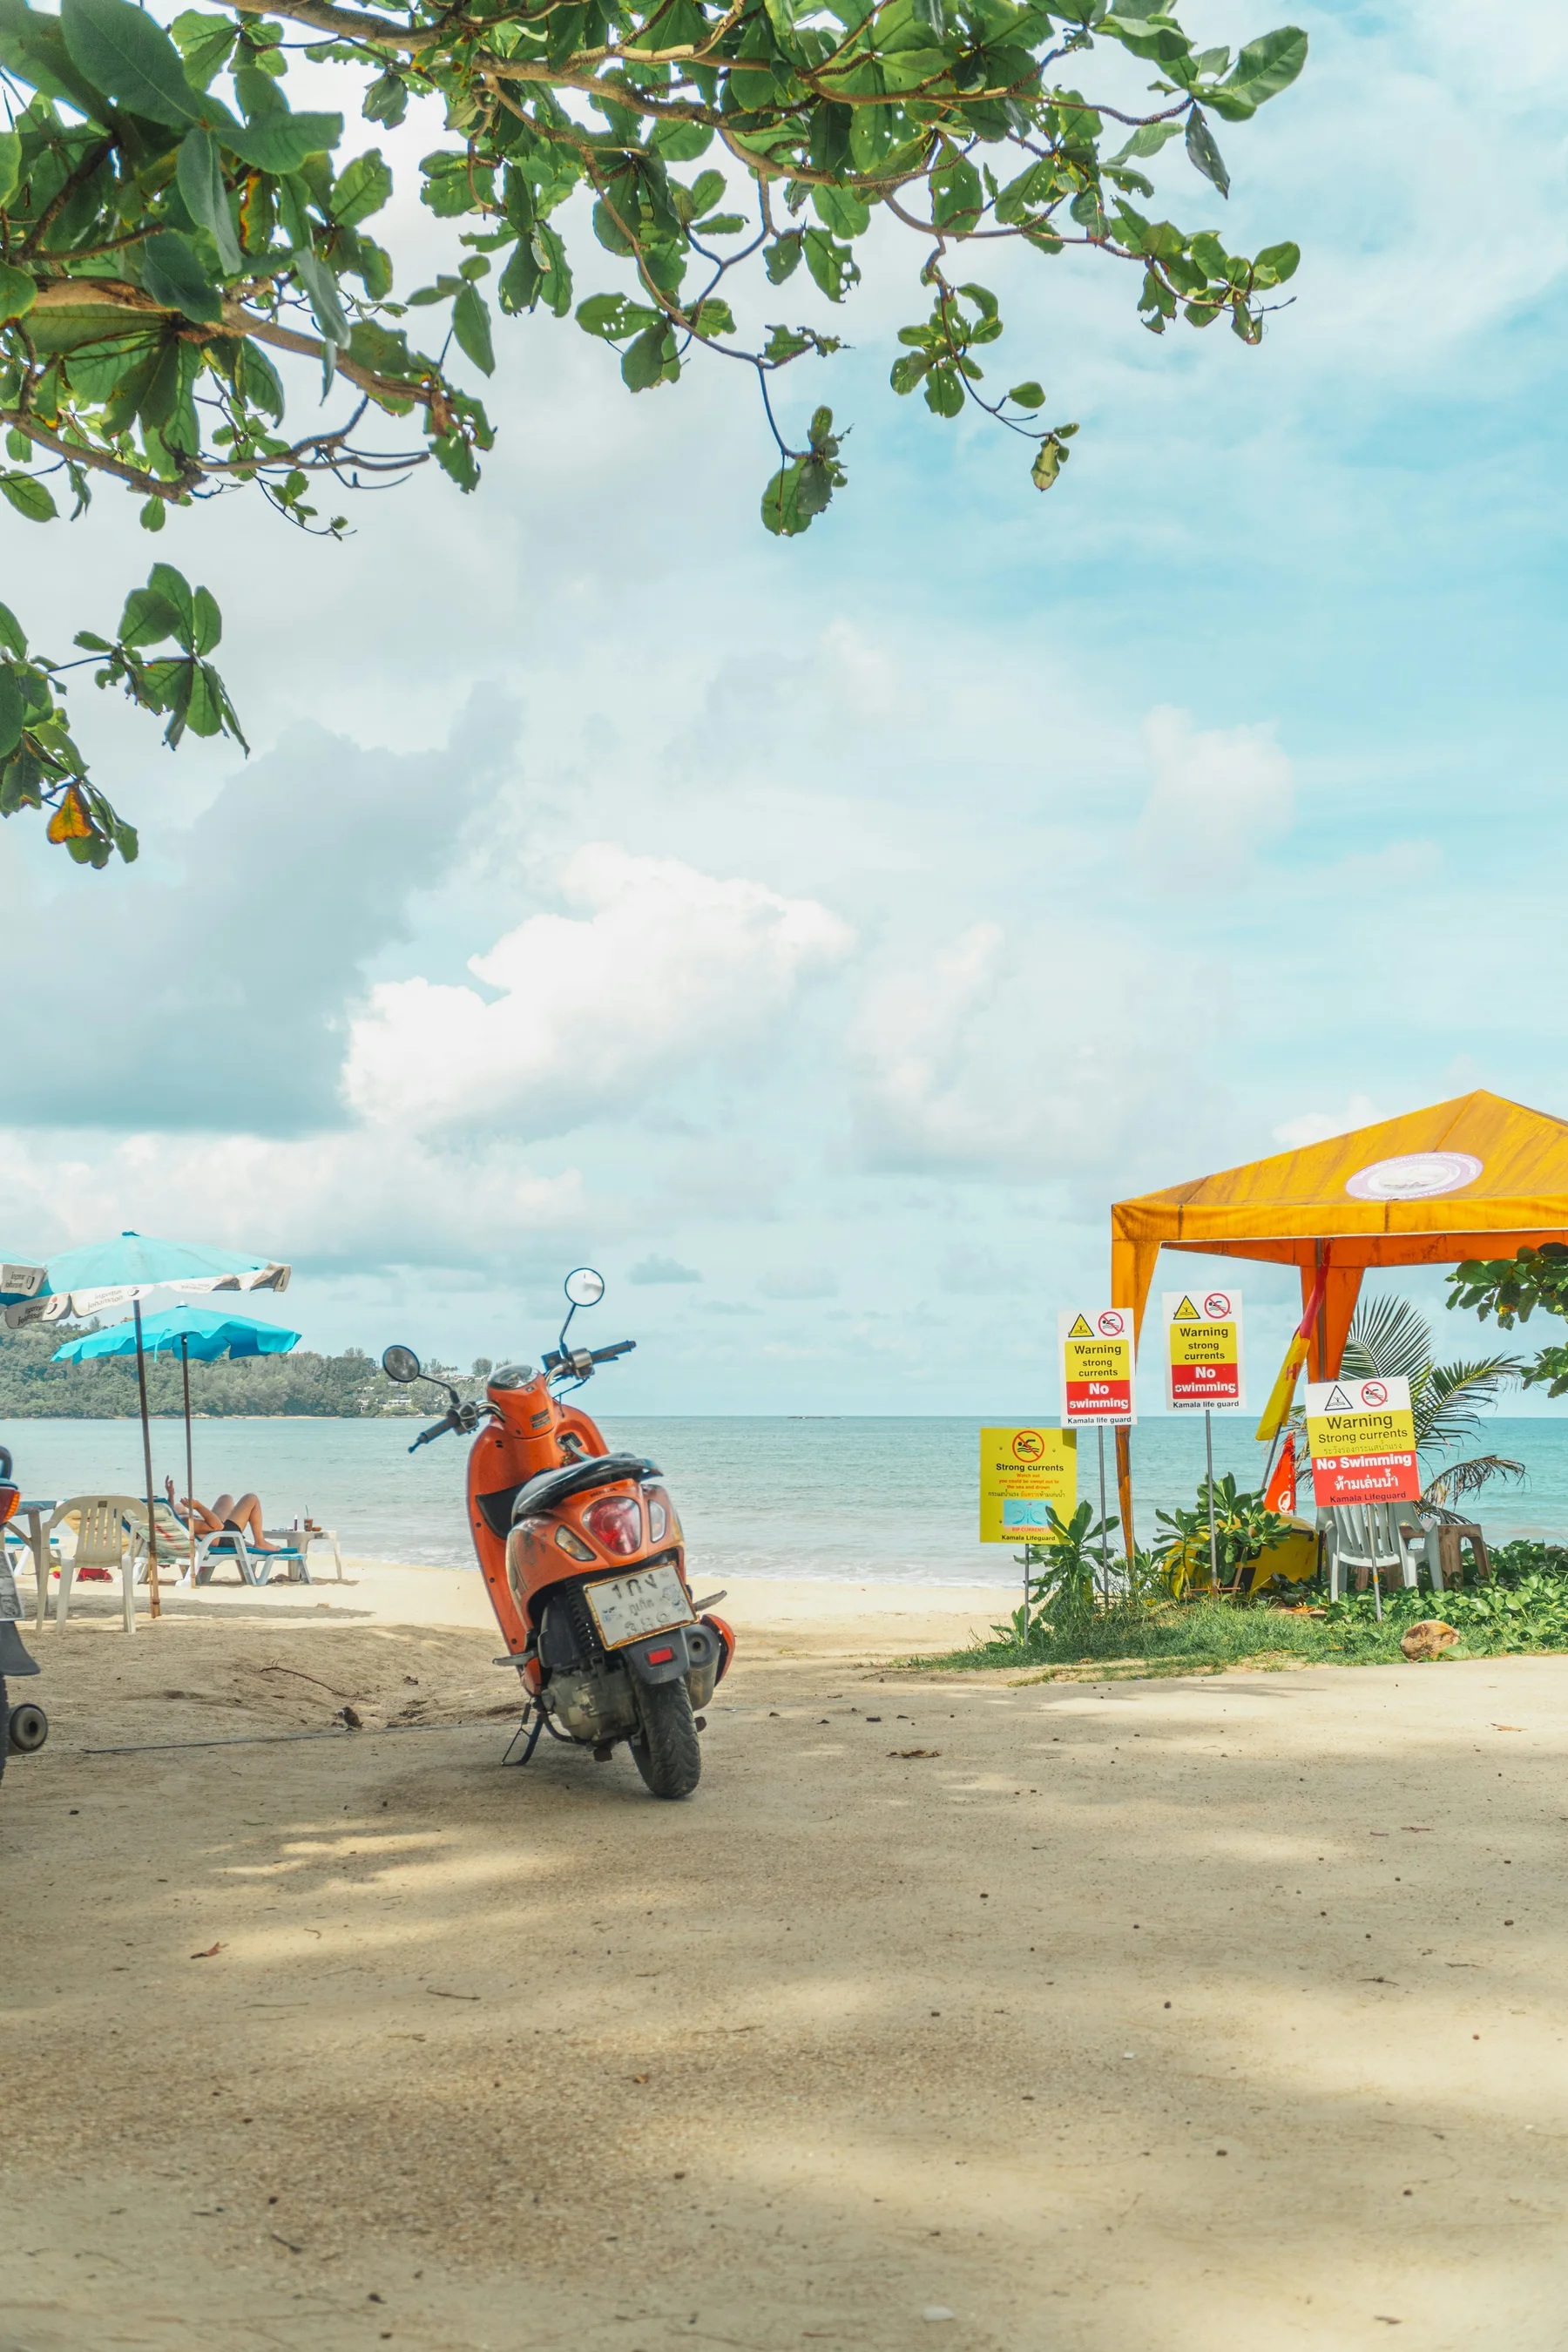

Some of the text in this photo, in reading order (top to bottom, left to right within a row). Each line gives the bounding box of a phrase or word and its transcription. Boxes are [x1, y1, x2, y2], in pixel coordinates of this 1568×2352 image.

[1179, 1327, 1229, 1338] Warning
[1074, 1344, 1121, 1355] Warning
[1188, 1342, 1220, 1350] strong
[1195, 1367, 1216, 1378] No
[1089, 1383, 1109, 1395] No
[1174, 1382, 1236, 1394] swimming
[1069, 1397, 1129, 1409] swimming
[1327, 1414, 1393, 1429] Warning
[1318, 1429, 1408, 1444] Strong currents
[996, 1463, 1025, 1472] Strong
[1316, 1454, 1412, 1470] No Swimming
[1335, 1468, 1399, 1490] ห้ามเล่นน้ำ
[1330, 1491, 1407, 1504] Kamala Lifeguard
